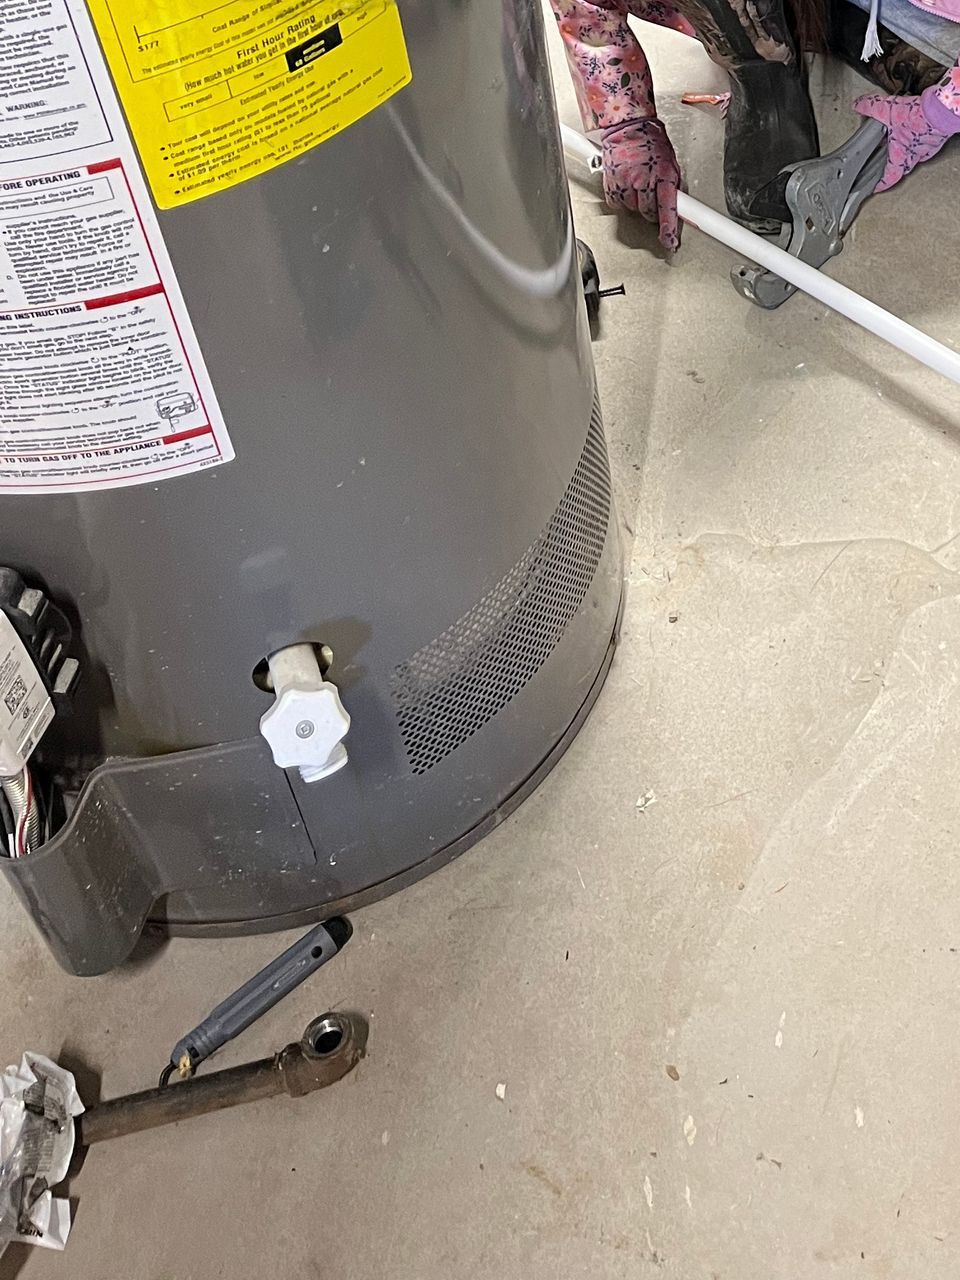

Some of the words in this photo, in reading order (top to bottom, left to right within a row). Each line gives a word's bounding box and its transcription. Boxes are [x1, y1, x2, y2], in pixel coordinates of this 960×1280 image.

[236, 44, 259, 60] First
[262, 29, 285, 49] Hour
[286, 14, 316, 37] Rating
[184, 80, 202, 92] (How
[203, 70, 222, 84] much
[223, 65, 235, 76] hot
[236, 57, 254, 70] water
[255, 51, 267, 64] you
[268, 44, 279, 57] get
[5, 99, 48, 112] WARNING:
[25, 170, 81, 188] OPERATING
[15, 305, 82, 320] INSTRUCTIONS
[112, 439, 162, 455] APPLIANCE
